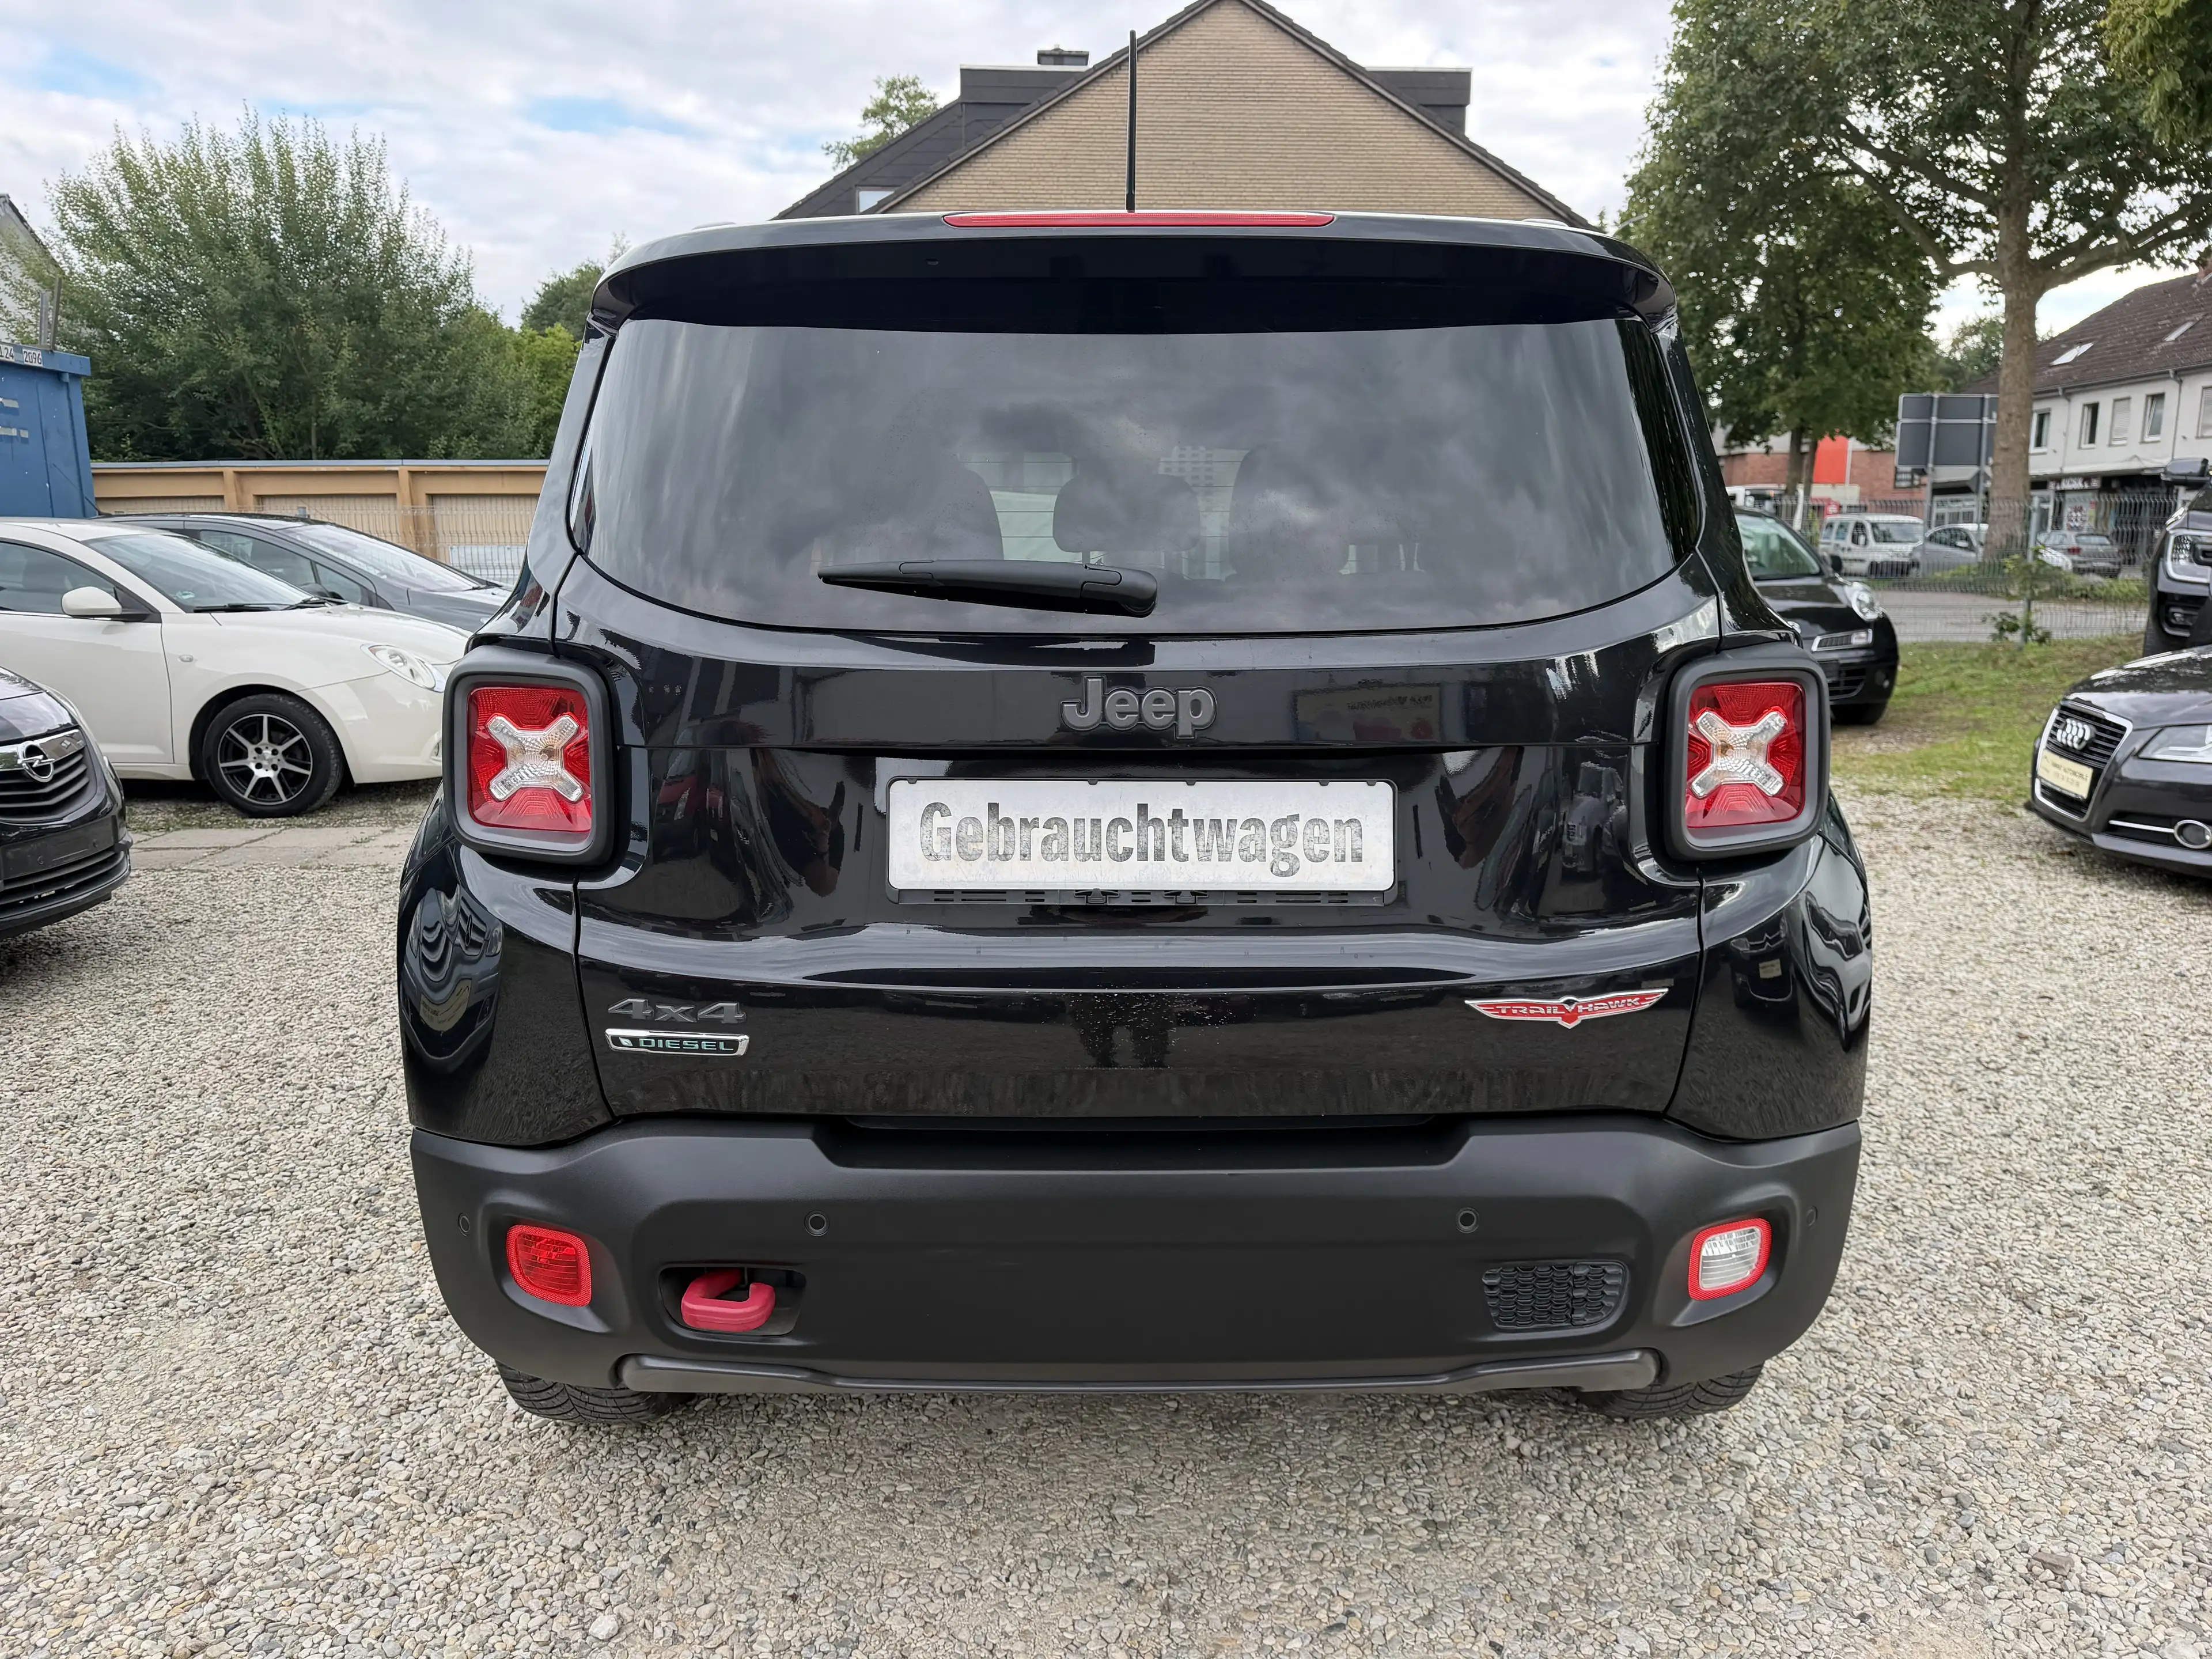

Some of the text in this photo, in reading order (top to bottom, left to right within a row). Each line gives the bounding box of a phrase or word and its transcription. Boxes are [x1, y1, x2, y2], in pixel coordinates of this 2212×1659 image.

[24, 350, 42, 365] 2096
[1060, 676, 1217, 740] Jeep
[919, 802, 1363, 878] Gebrauchtwagen
[639, 1037, 734, 1051] DIESEL
